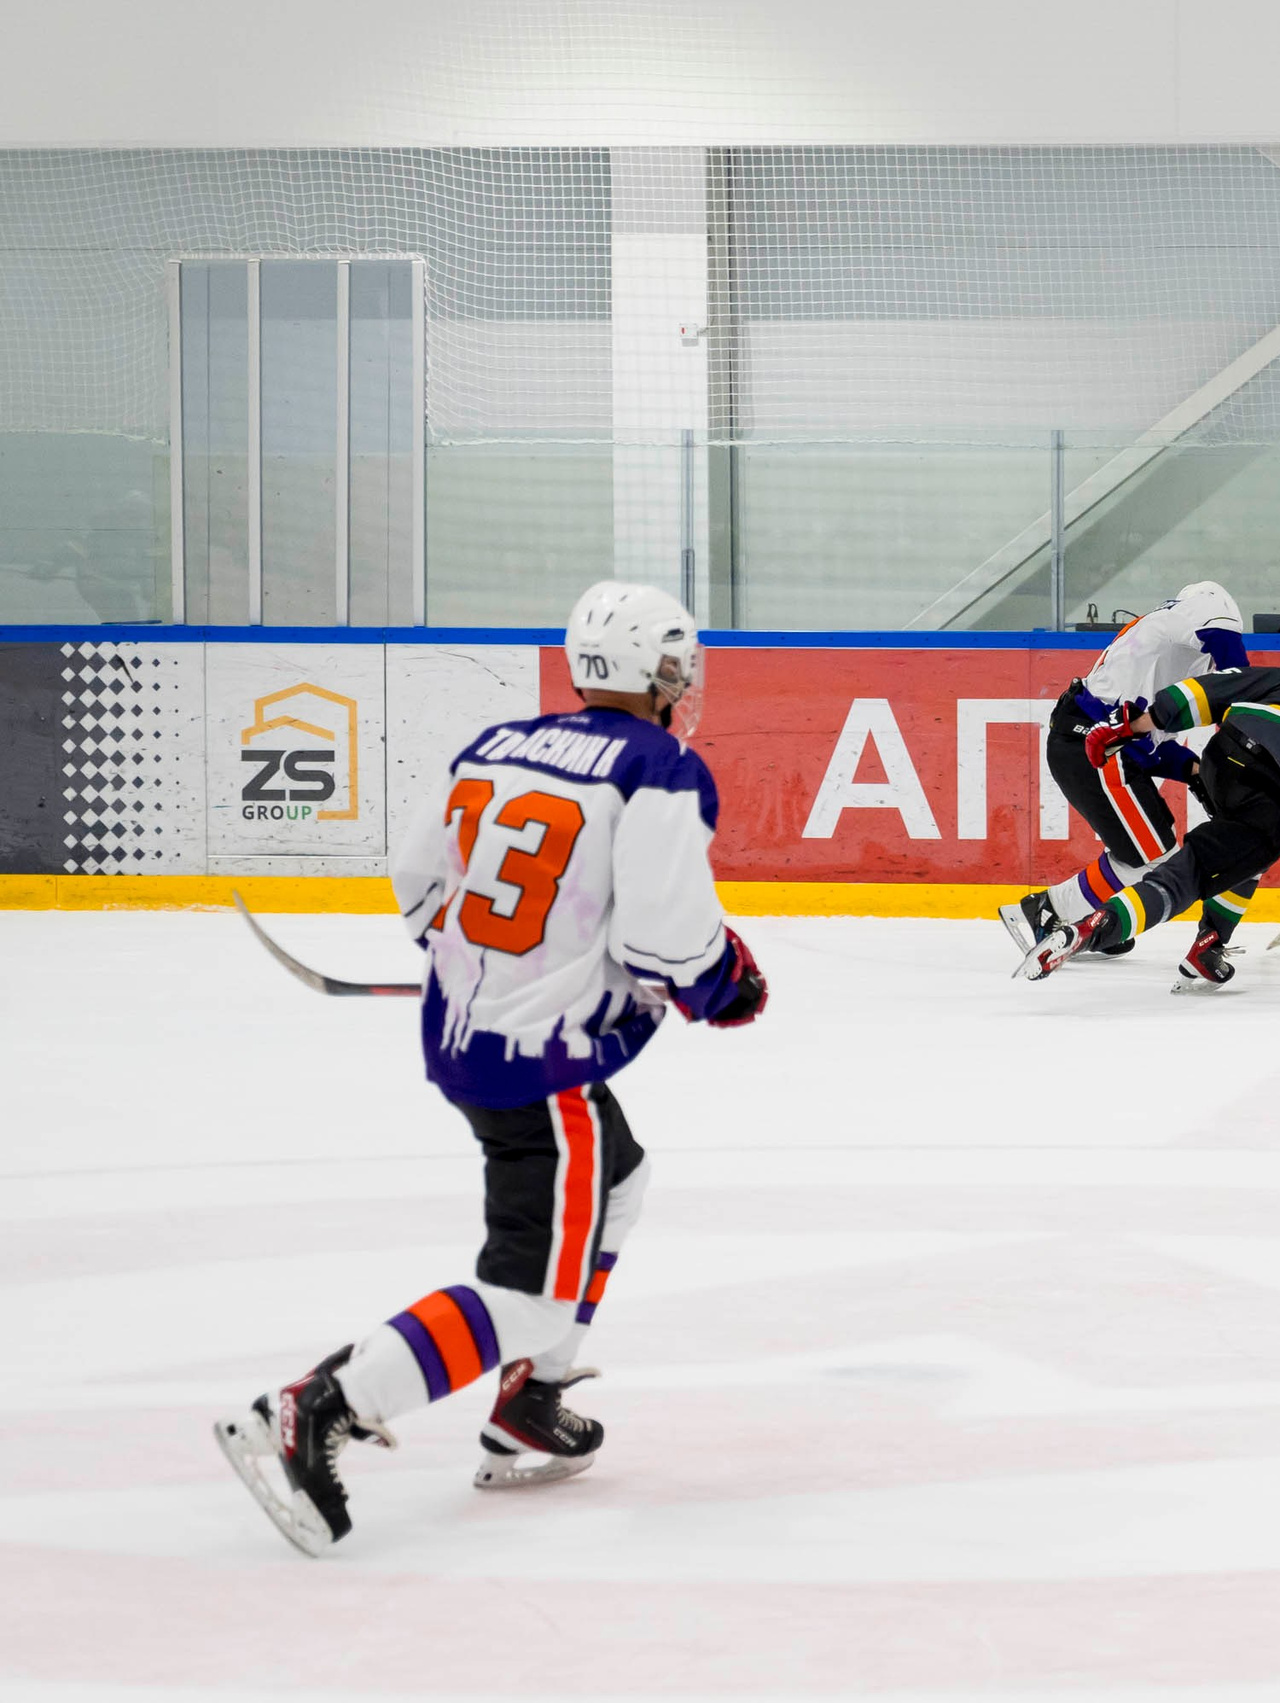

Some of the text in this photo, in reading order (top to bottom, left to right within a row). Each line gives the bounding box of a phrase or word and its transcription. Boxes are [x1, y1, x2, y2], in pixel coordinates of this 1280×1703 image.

[578, 653, 609, 680] 70
[240, 749, 335, 802] ZS
[242, 805, 312, 820] GROUP
[430, 778, 586, 957] 73
[502, 1363, 527, 1391] CCM
